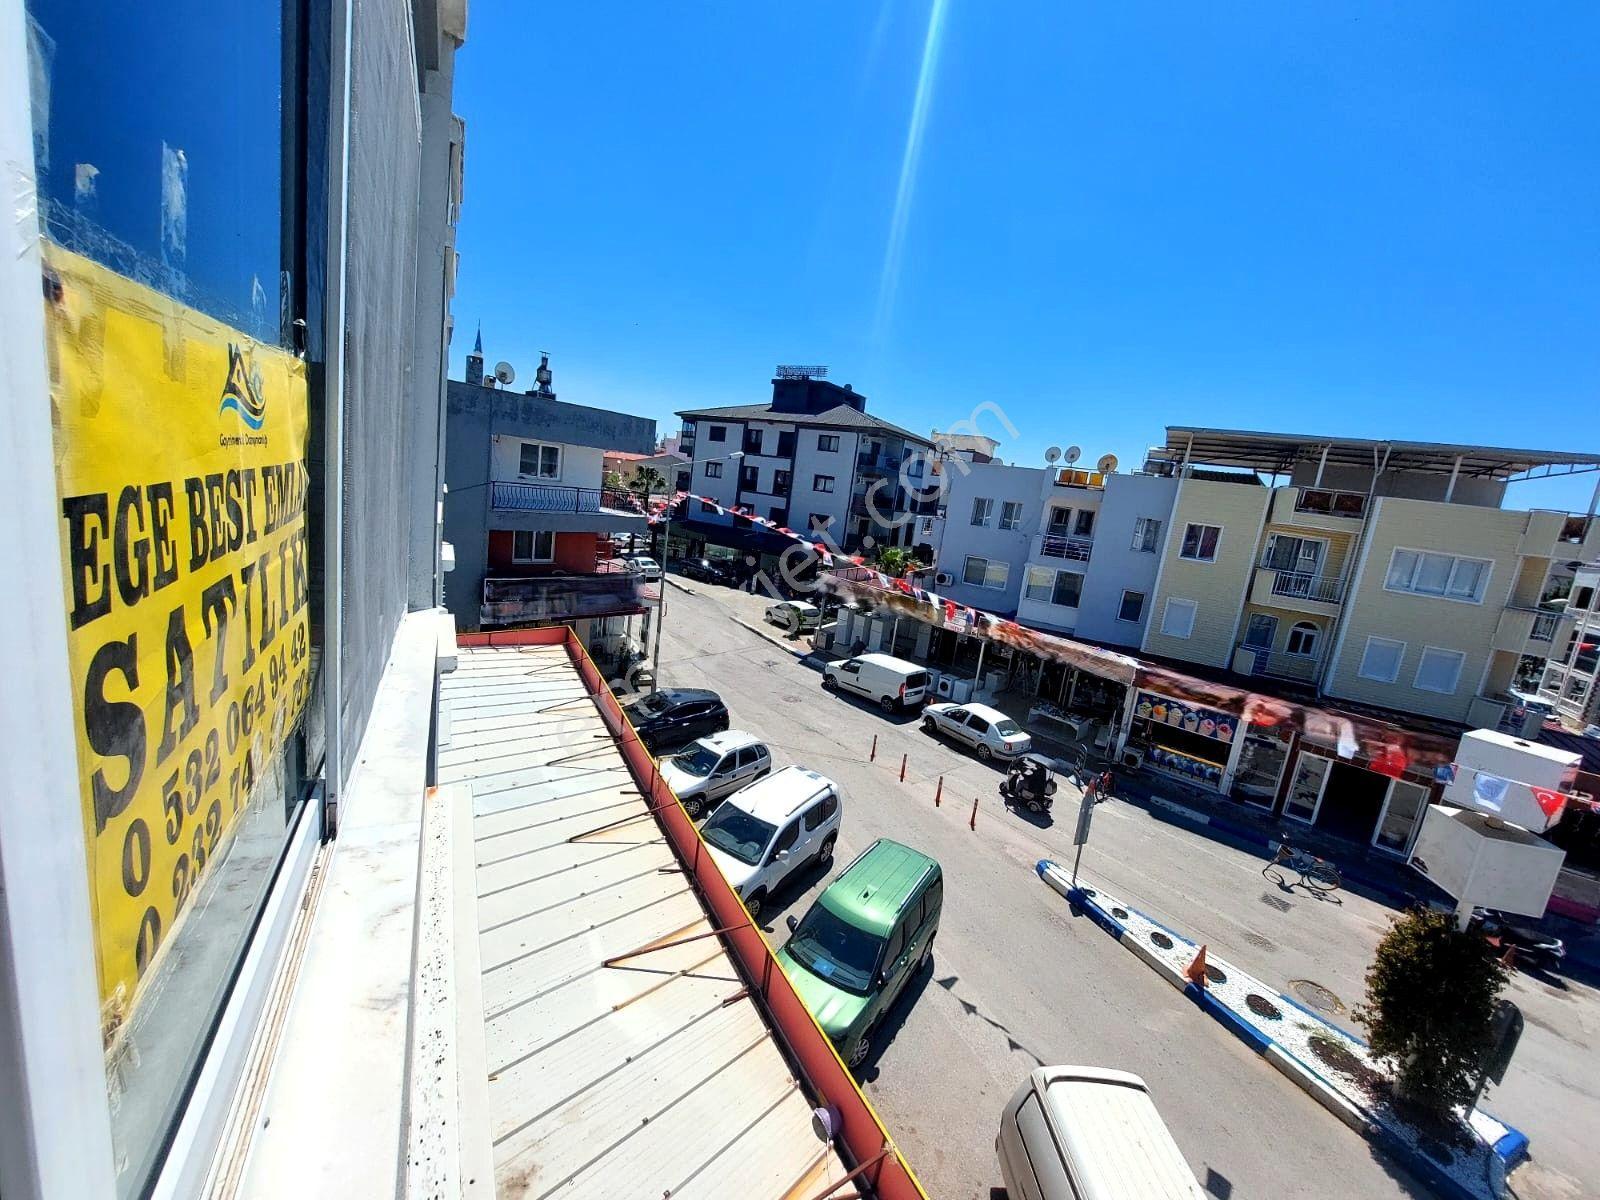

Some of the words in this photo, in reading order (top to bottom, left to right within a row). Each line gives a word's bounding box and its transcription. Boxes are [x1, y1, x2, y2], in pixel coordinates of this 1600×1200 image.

[63, 482, 178, 631] EGE
[185, 468, 257, 573] BEST
[262, 462, 307, 535] EMLA
[85, 528, 307, 837] SATILIK
[122, 818, 151, 897] 0
[162, 728, 221, 845] 532
[227, 672, 266, 755] 064
[269, 643, 287, 700] 94
